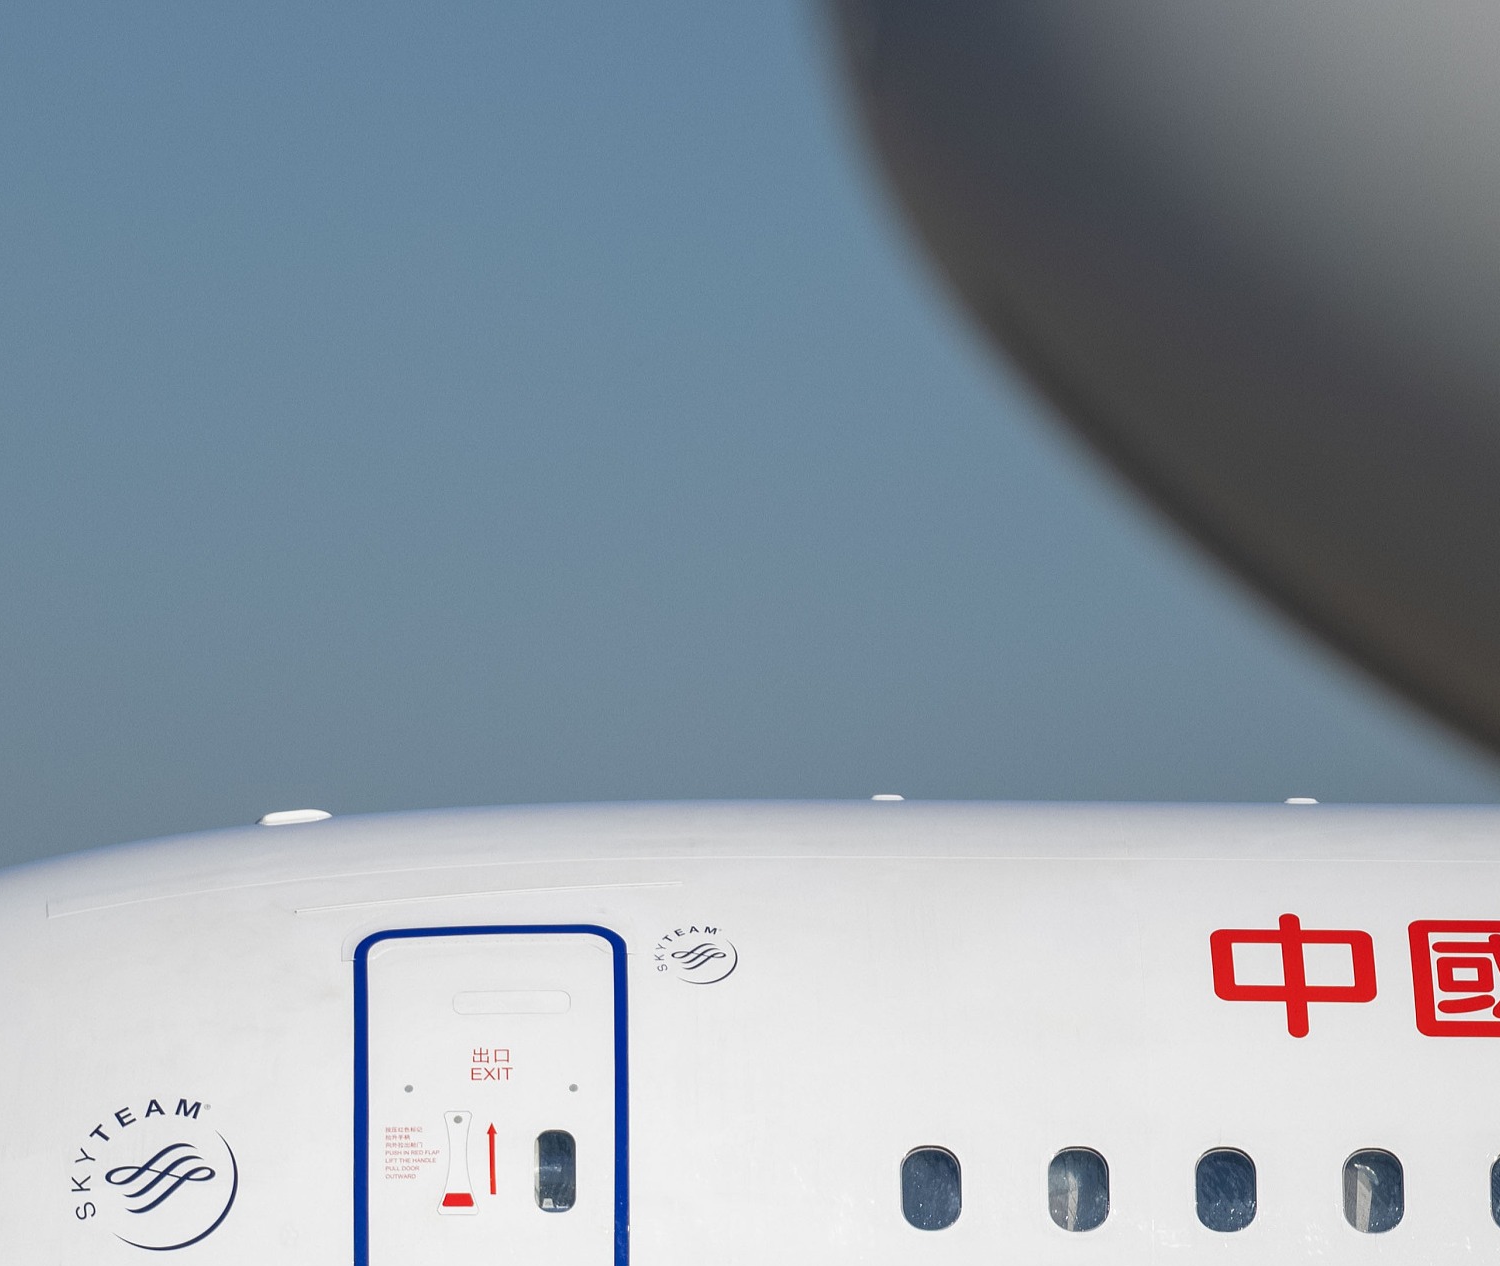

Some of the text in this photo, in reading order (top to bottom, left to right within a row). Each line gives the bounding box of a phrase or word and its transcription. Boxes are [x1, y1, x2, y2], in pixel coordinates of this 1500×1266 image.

[654, 926, 718, 971] SKYTEAM
[472, 1047, 511, 1064] 出口
[470, 1067, 513, 1081] EXIT
[71, 1098, 202, 1220] SKYTEAM
